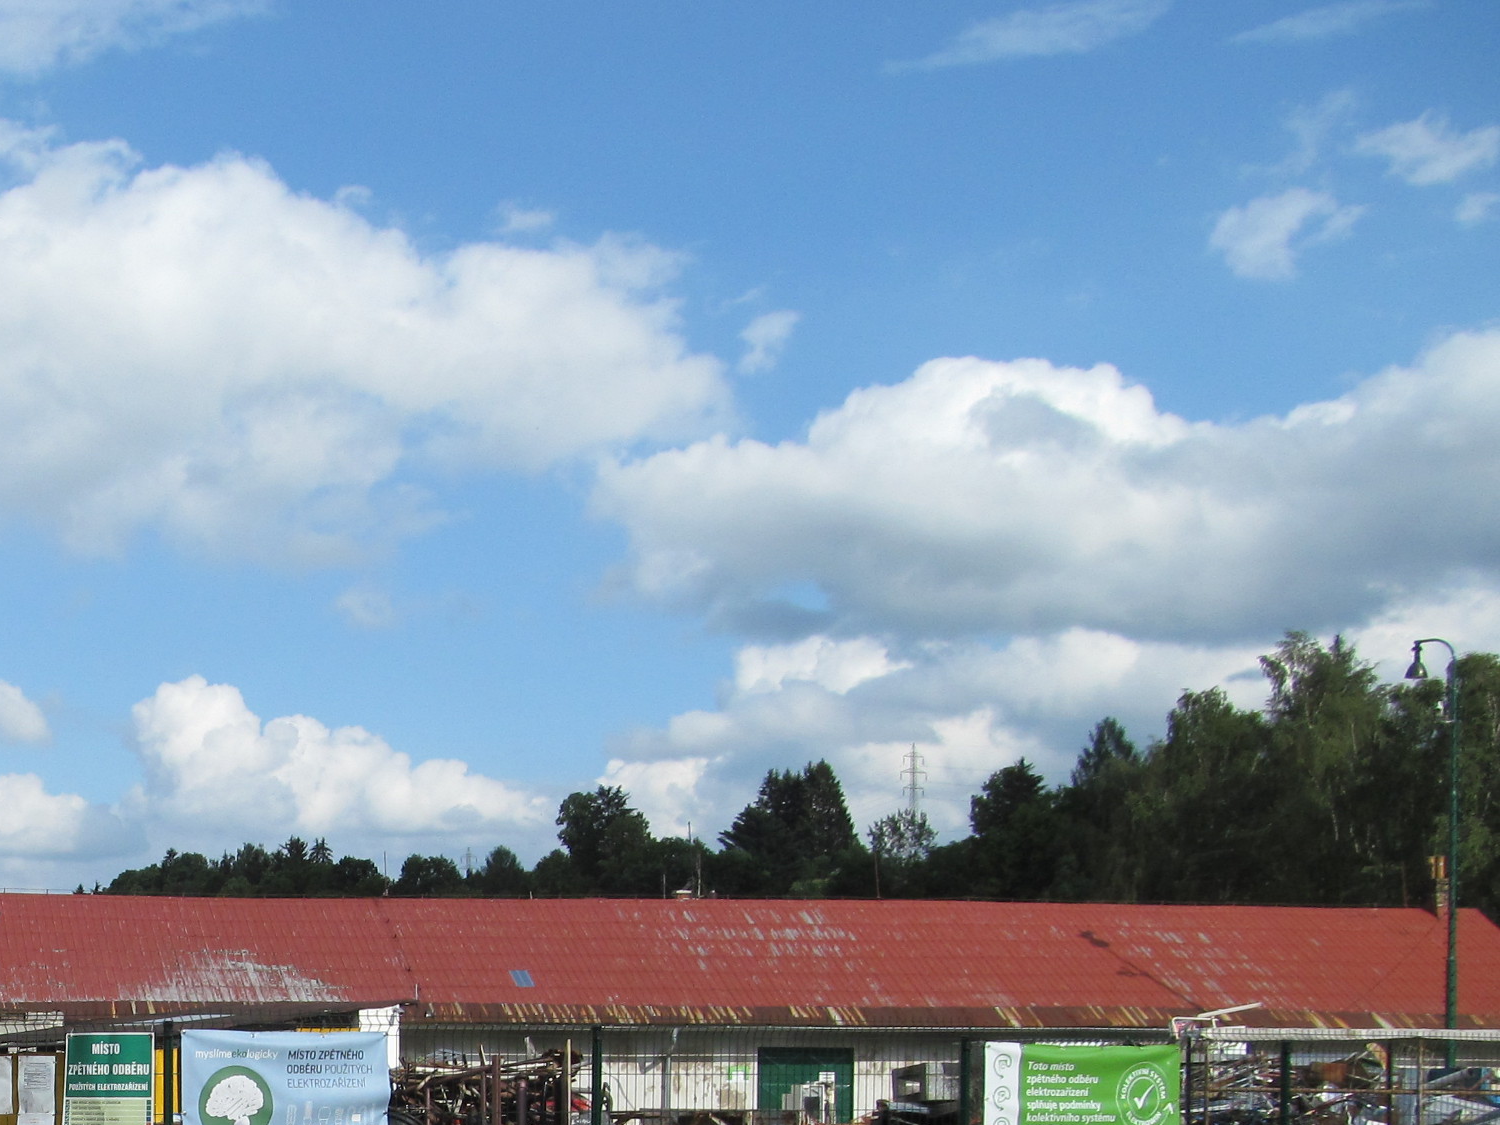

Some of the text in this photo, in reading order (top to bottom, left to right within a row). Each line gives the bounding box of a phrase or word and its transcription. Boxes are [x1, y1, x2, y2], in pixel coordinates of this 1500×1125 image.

[92, 1041, 120, 1054] MÍSTO
[288, 1048, 364, 1060] MÍSTO ZPĚTNÉHO
[68, 1062, 150, 1075] ZPĚTNÉHO ODBĚRU
[286, 1063, 373, 1074] ODBĚRU POUŽITÝCH
[1027, 1061, 1075, 1071] Toto místo
[287, 1078, 366, 1089] ELEKTROZAŘÍZENÍ
[1026, 1075, 1099, 1085] zpětného odběru
[1026, 1087, 1089, 1097] elektrozařízení
[1026, 1100, 1101, 1111] splňuje podmínky
[1026, 1113, 1116, 1123] kolektivního systému
